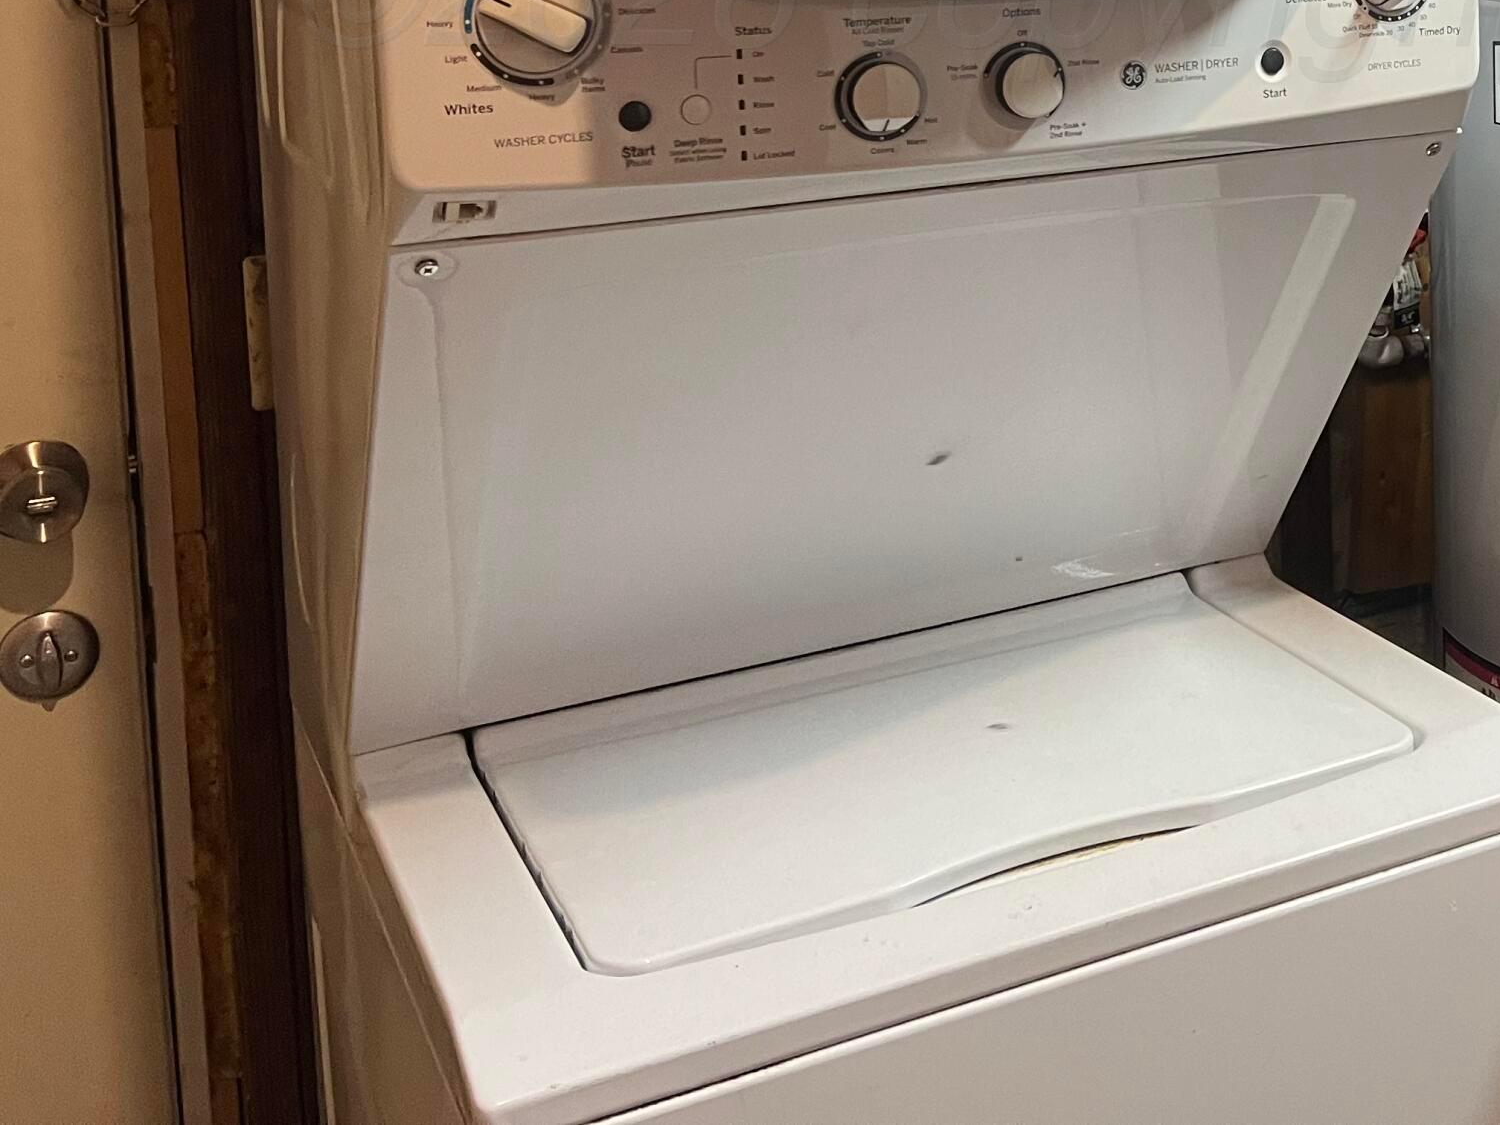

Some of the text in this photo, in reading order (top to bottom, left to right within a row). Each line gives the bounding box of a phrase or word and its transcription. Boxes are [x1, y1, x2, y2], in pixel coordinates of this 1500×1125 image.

[1002, 6, 1042, 21] Options
[426, 20, 453, 29] Heavy
[842, 15, 912, 29] Temperature
[734, 26, 772, 36] Status
[1419, 26, 1460, 36] Timed Dry
[444, 55, 467, 65] Light
[1154, 57, 1239, 73] WASHER DRYER
[1368, 59, 1421, 72] DRYER CYCLES
[466, 83, 502, 92] Medium
[1263, 87, 1288, 99] Start
[529, 93, 555, 103] Heavy
[444, 103, 494, 116] Whites
[494, 131, 593, 148] WASHER CYCLES
[622, 145, 655, 159] Start
